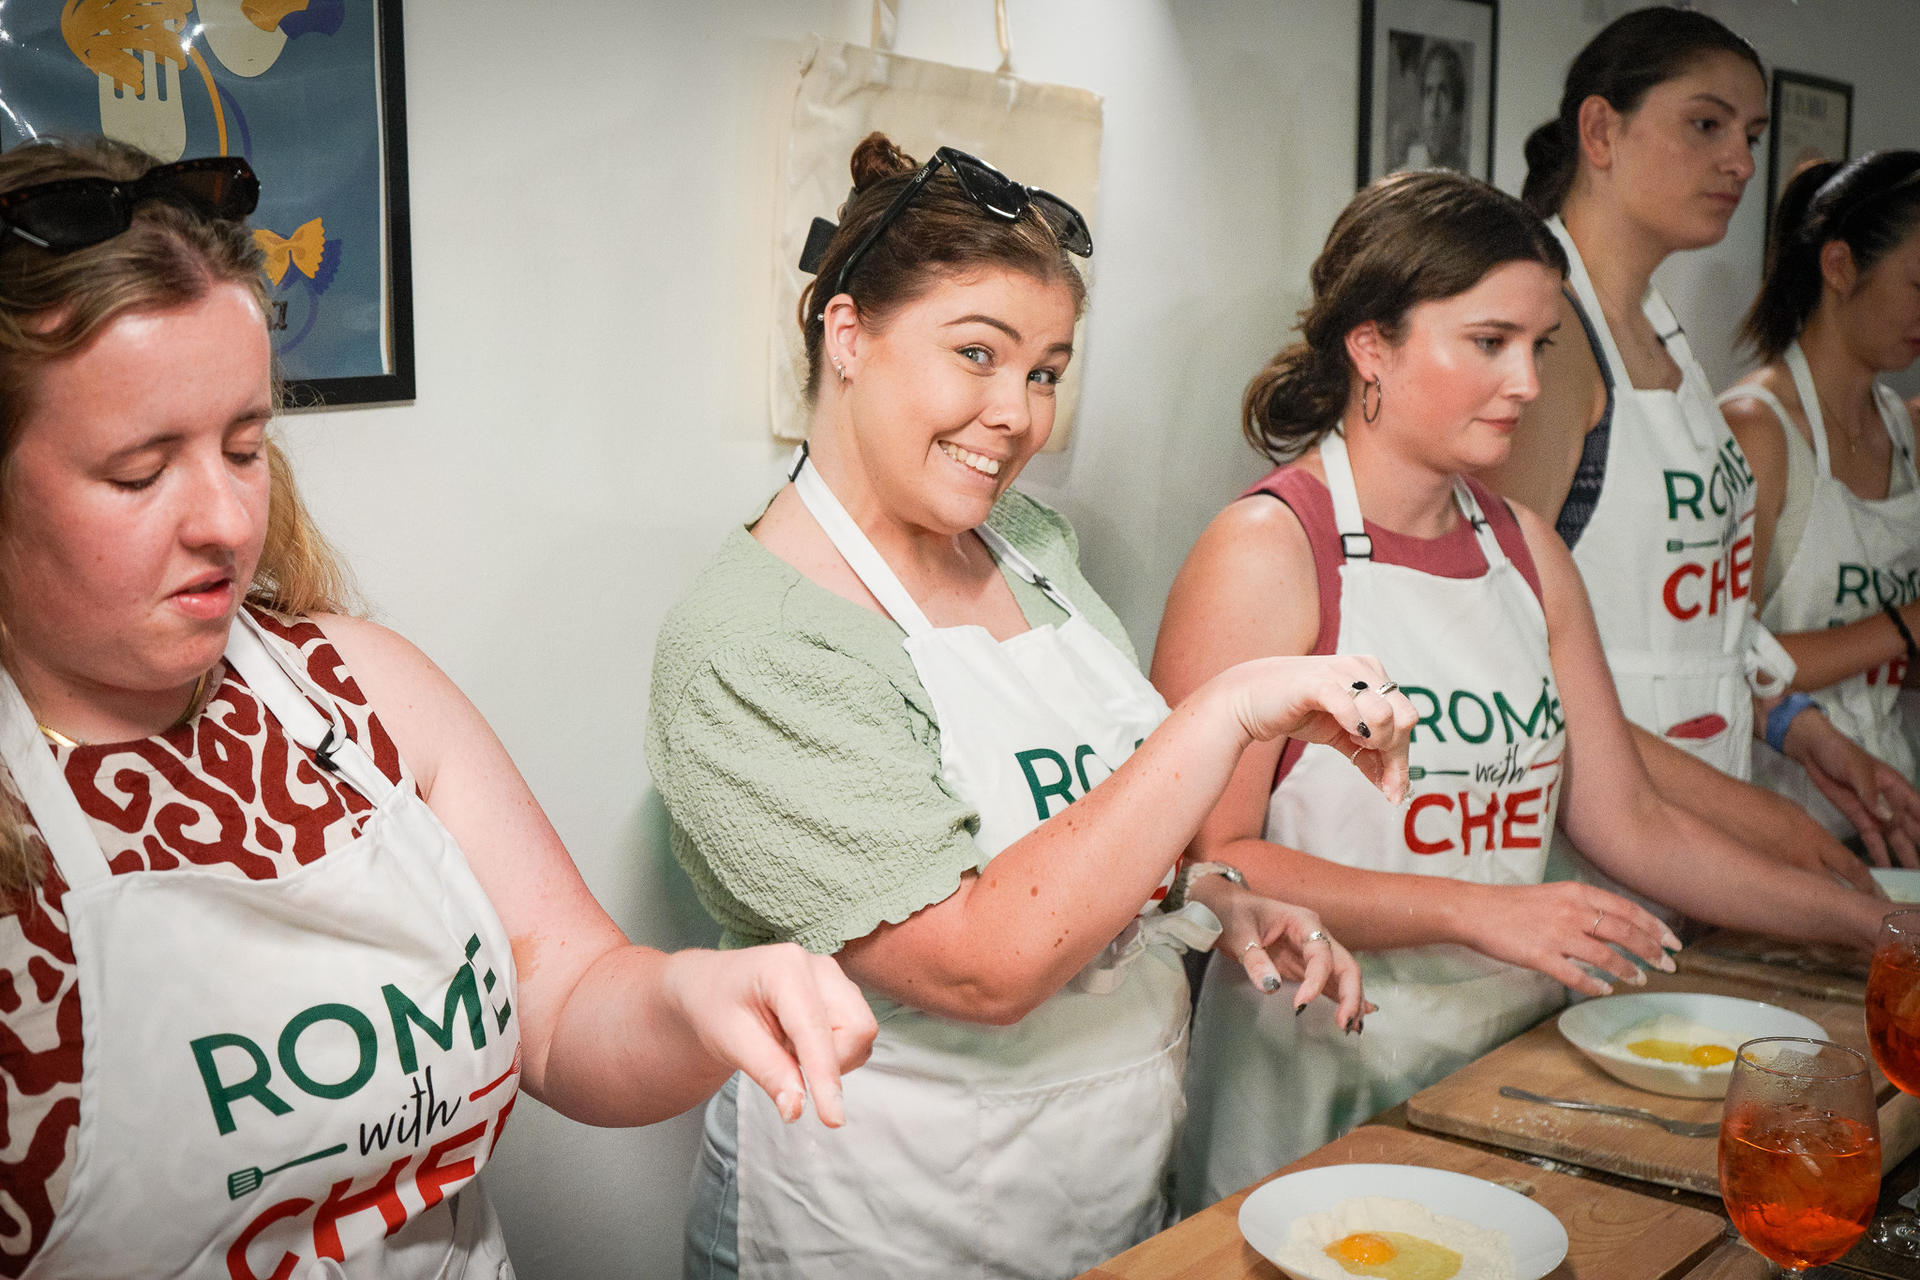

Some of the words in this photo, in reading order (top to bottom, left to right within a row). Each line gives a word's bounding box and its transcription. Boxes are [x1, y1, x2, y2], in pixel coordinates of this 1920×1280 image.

[1663, 533, 1753, 622] CHE
[1836, 562, 1920, 607] ROM
[1475, 744, 1527, 788] with
[359, 1065, 462, 1157] with
